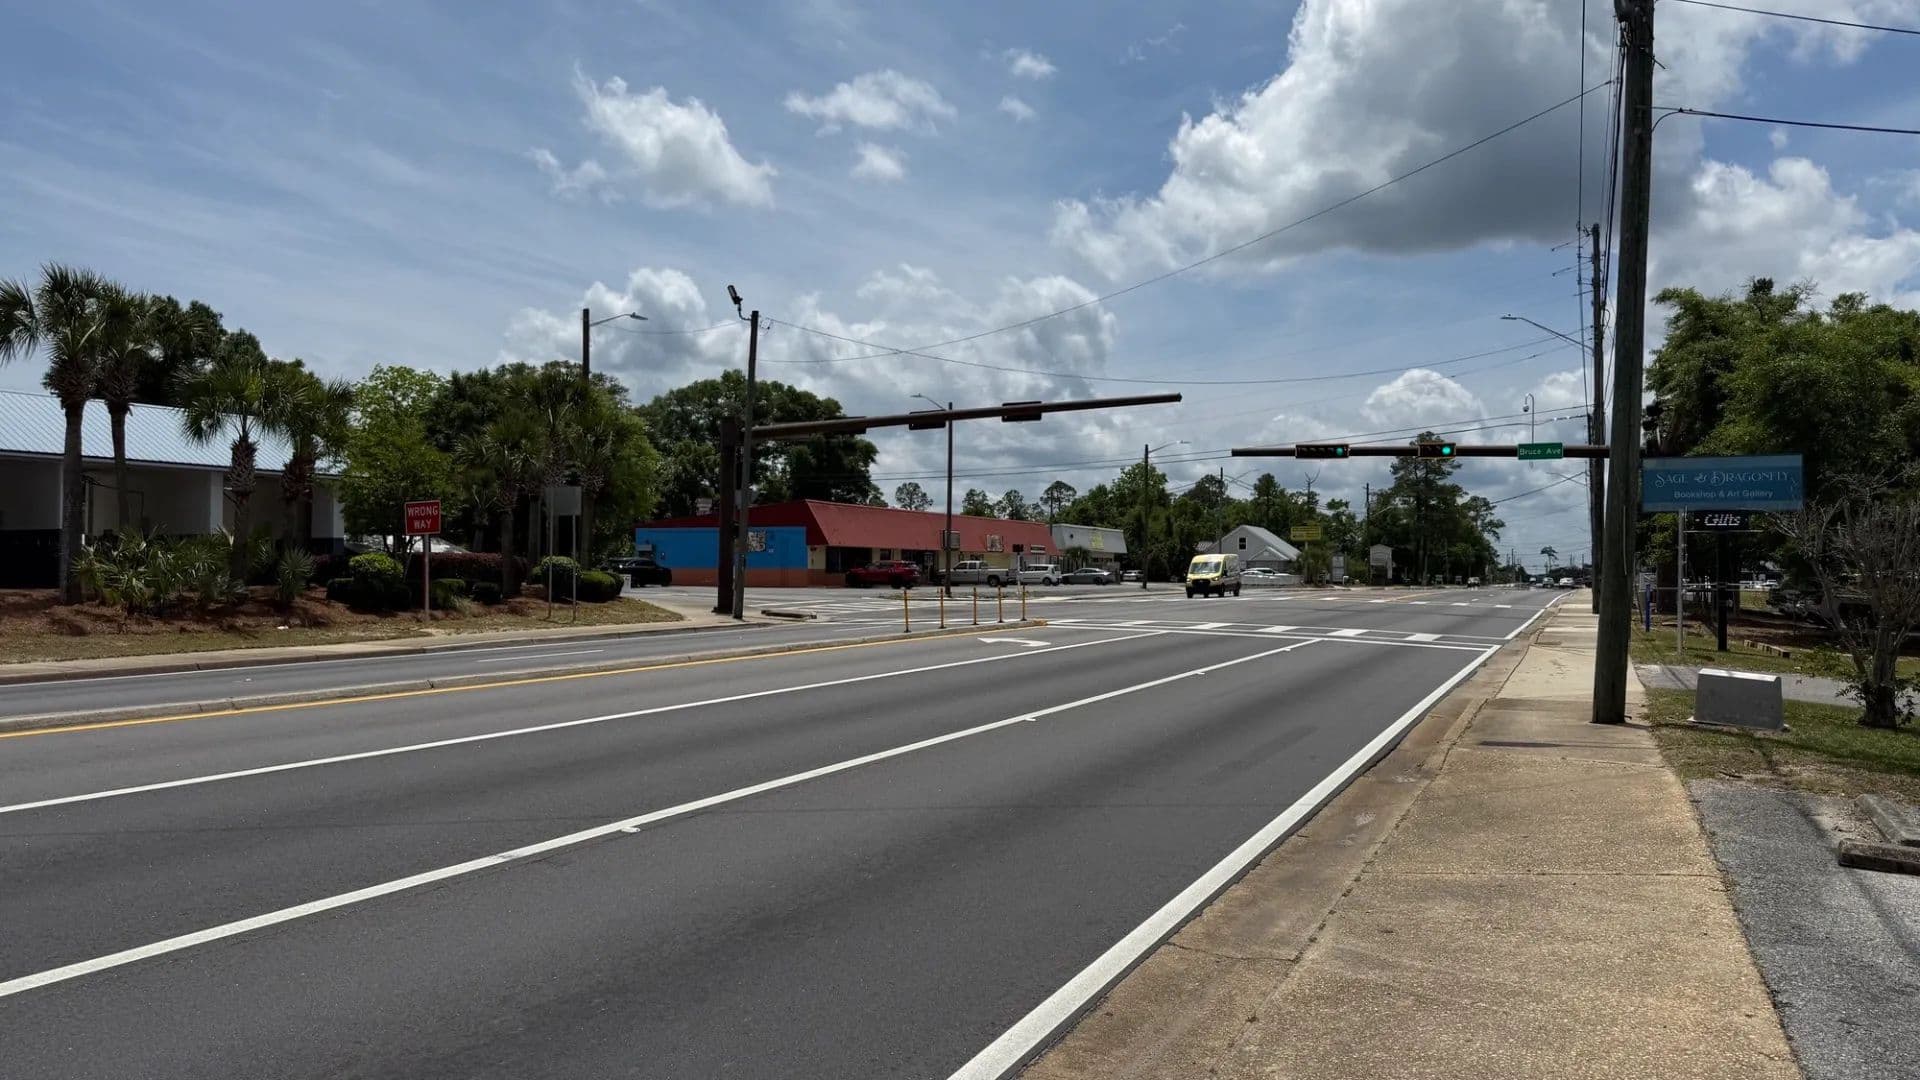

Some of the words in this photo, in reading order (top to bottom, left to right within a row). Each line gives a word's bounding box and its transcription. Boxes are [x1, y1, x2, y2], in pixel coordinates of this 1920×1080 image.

[1520, 448, 1541, 456] Bruce
[1546, 447, 1561, 455] Ave
[1674, 490, 1716, 499] Bookshop
[1742, 489, 1773, 498] Gallery
[407, 505, 439, 516] WRONG
[414, 518, 432, 529] WAY
